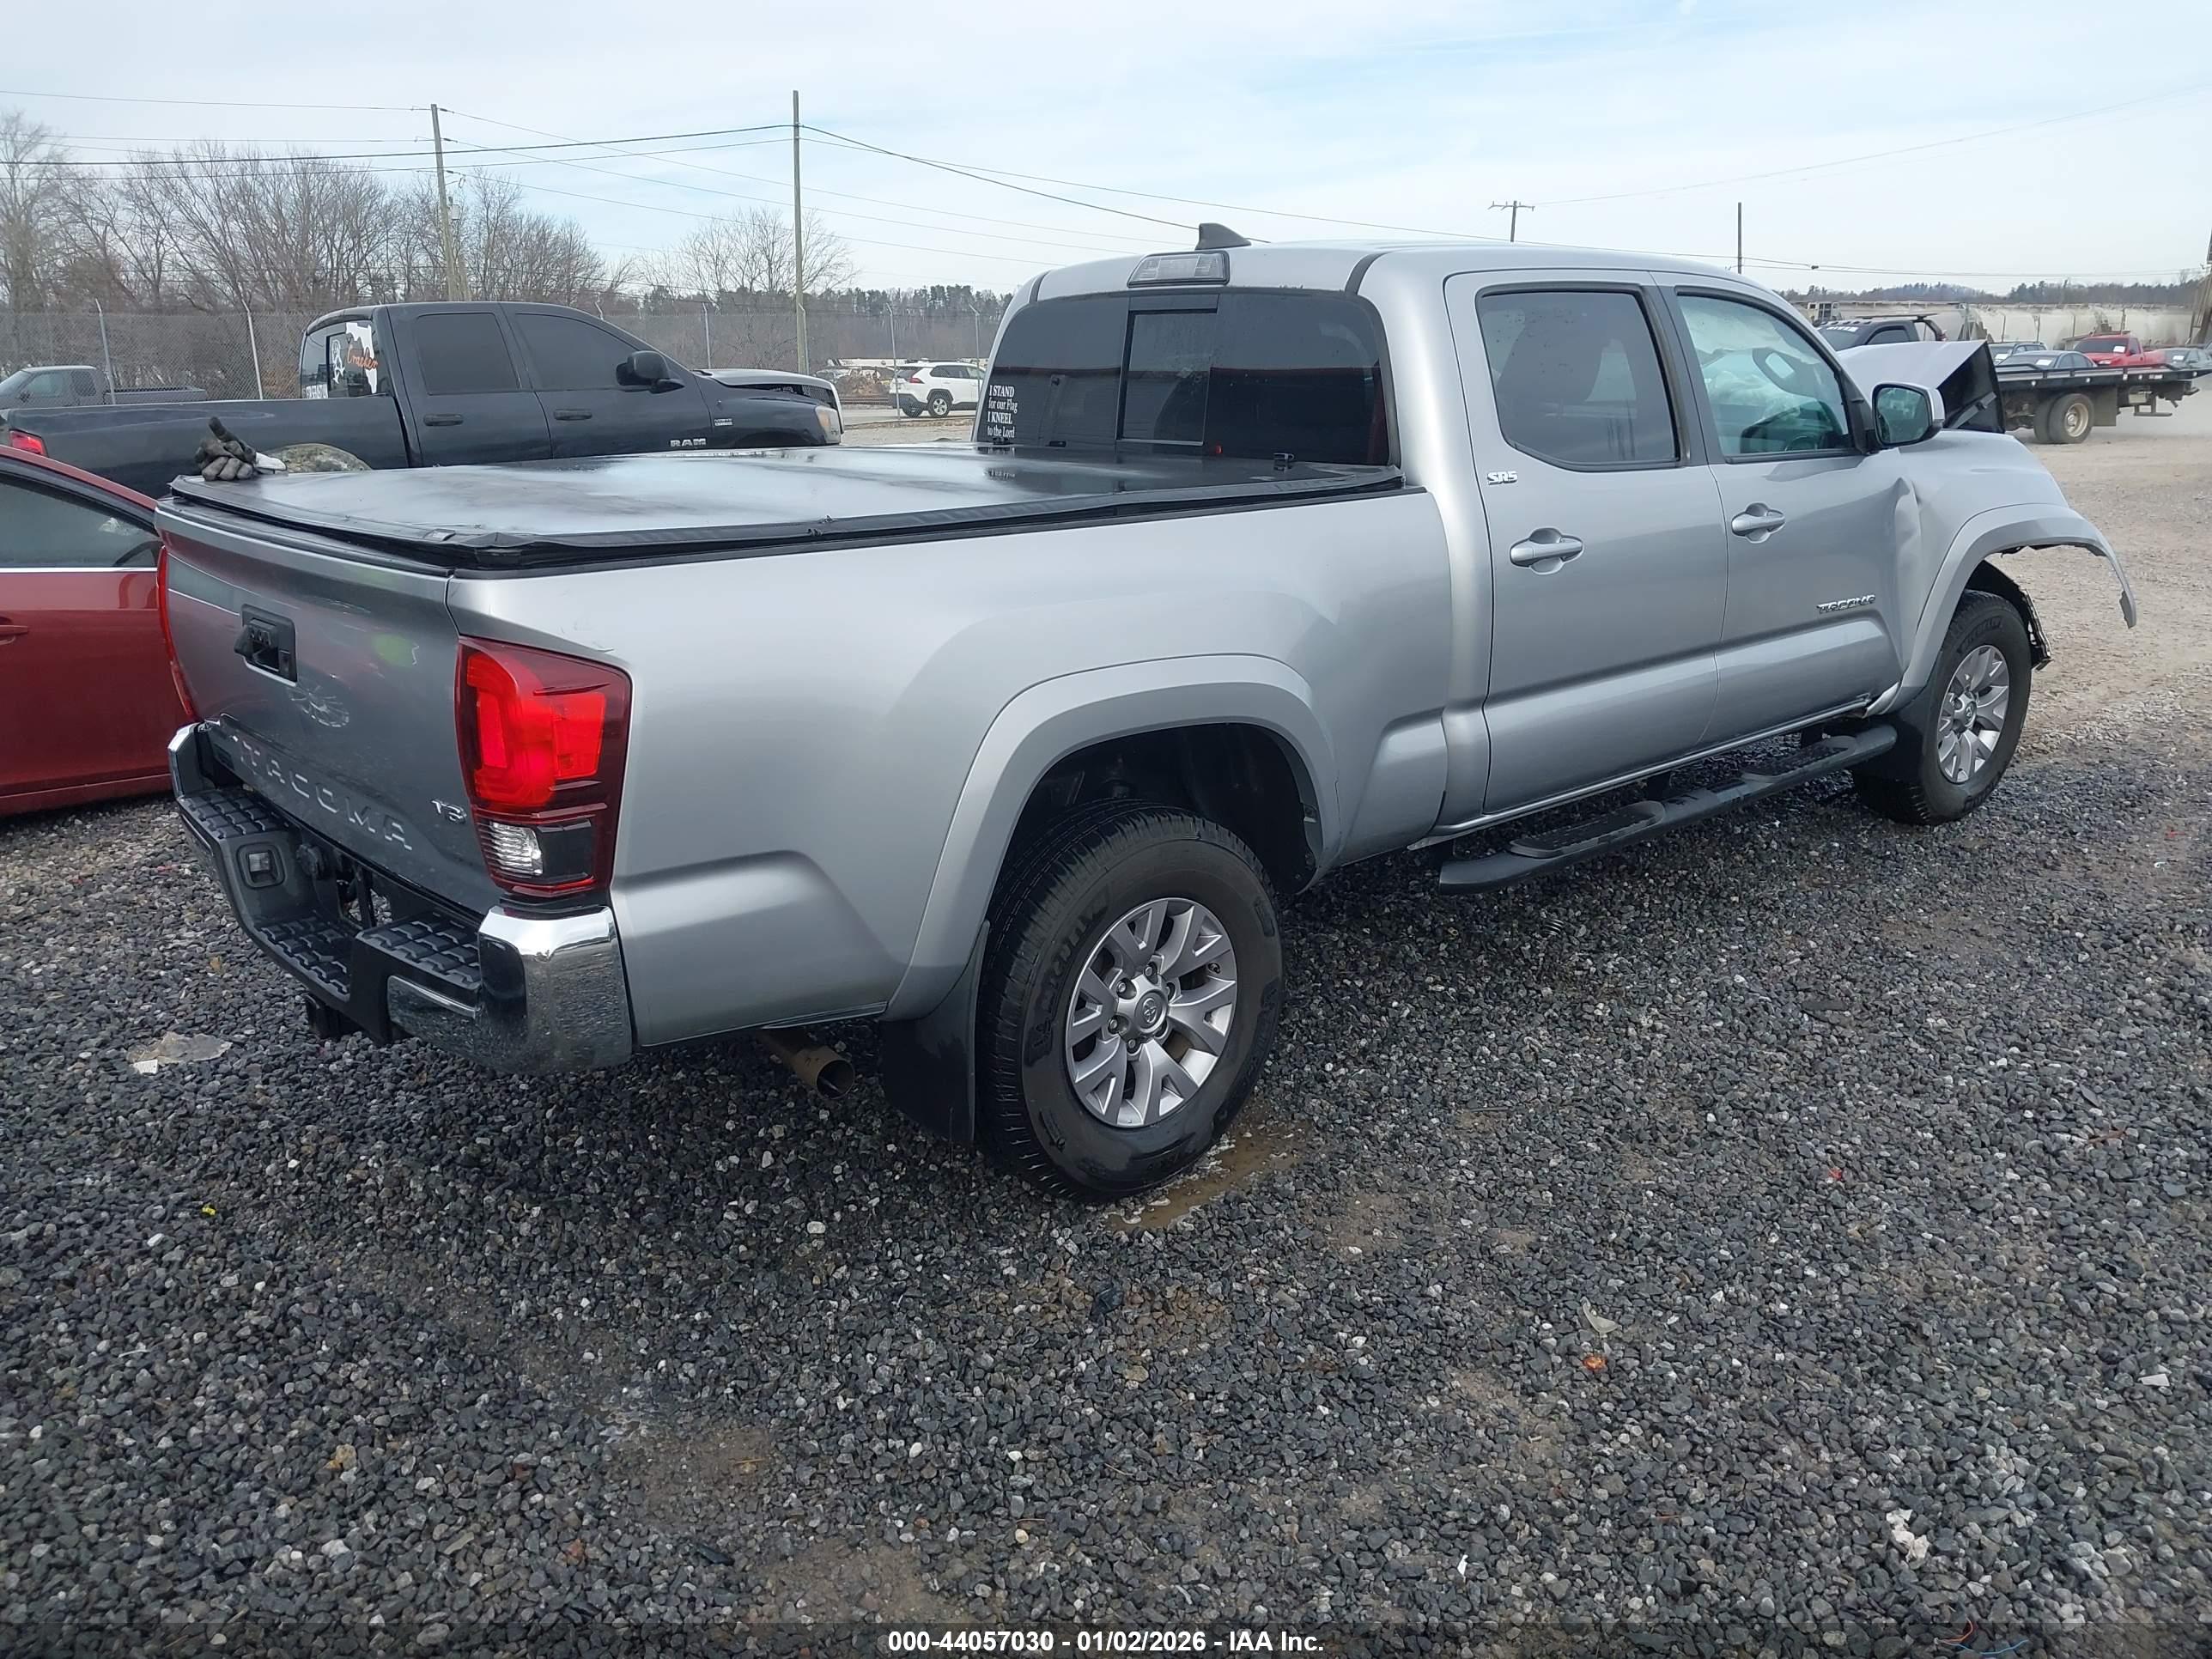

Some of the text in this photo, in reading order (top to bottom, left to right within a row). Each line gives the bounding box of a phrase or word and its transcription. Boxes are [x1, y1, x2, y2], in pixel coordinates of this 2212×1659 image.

[989, 385, 1015, 398] I STAND
[996, 400, 1006, 410] our
[1006, 398, 1018, 414] Flag
[988, 410, 1013, 425] I KNEEL
[987, 424, 1015, 439] to the Lord
[670, 438, 707, 447] RAM
[1486, 470, 1518, 485] SR5
[236, 737, 413, 852] TACOMA
